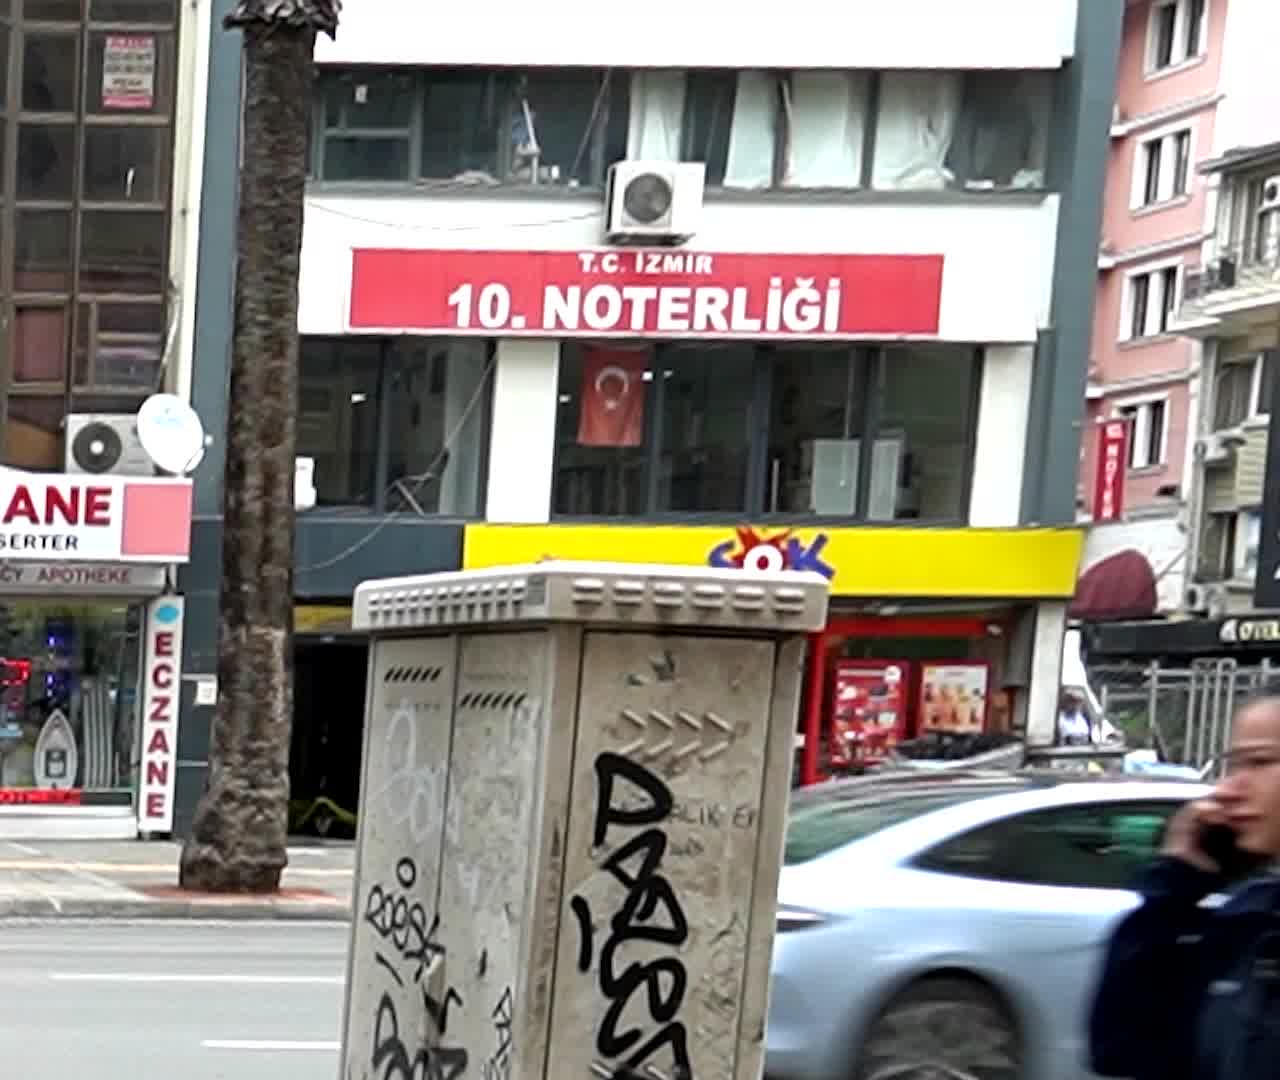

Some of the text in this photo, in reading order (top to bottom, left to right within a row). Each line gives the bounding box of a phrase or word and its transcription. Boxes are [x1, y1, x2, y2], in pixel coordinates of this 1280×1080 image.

[578, 252, 626, 273] T.C.
[447, 276, 842, 333] 10. NOTERLİĞİ
[37, 567, 132, 586] APOTHEKE
[146, 631, 174, 818] ECZANE
